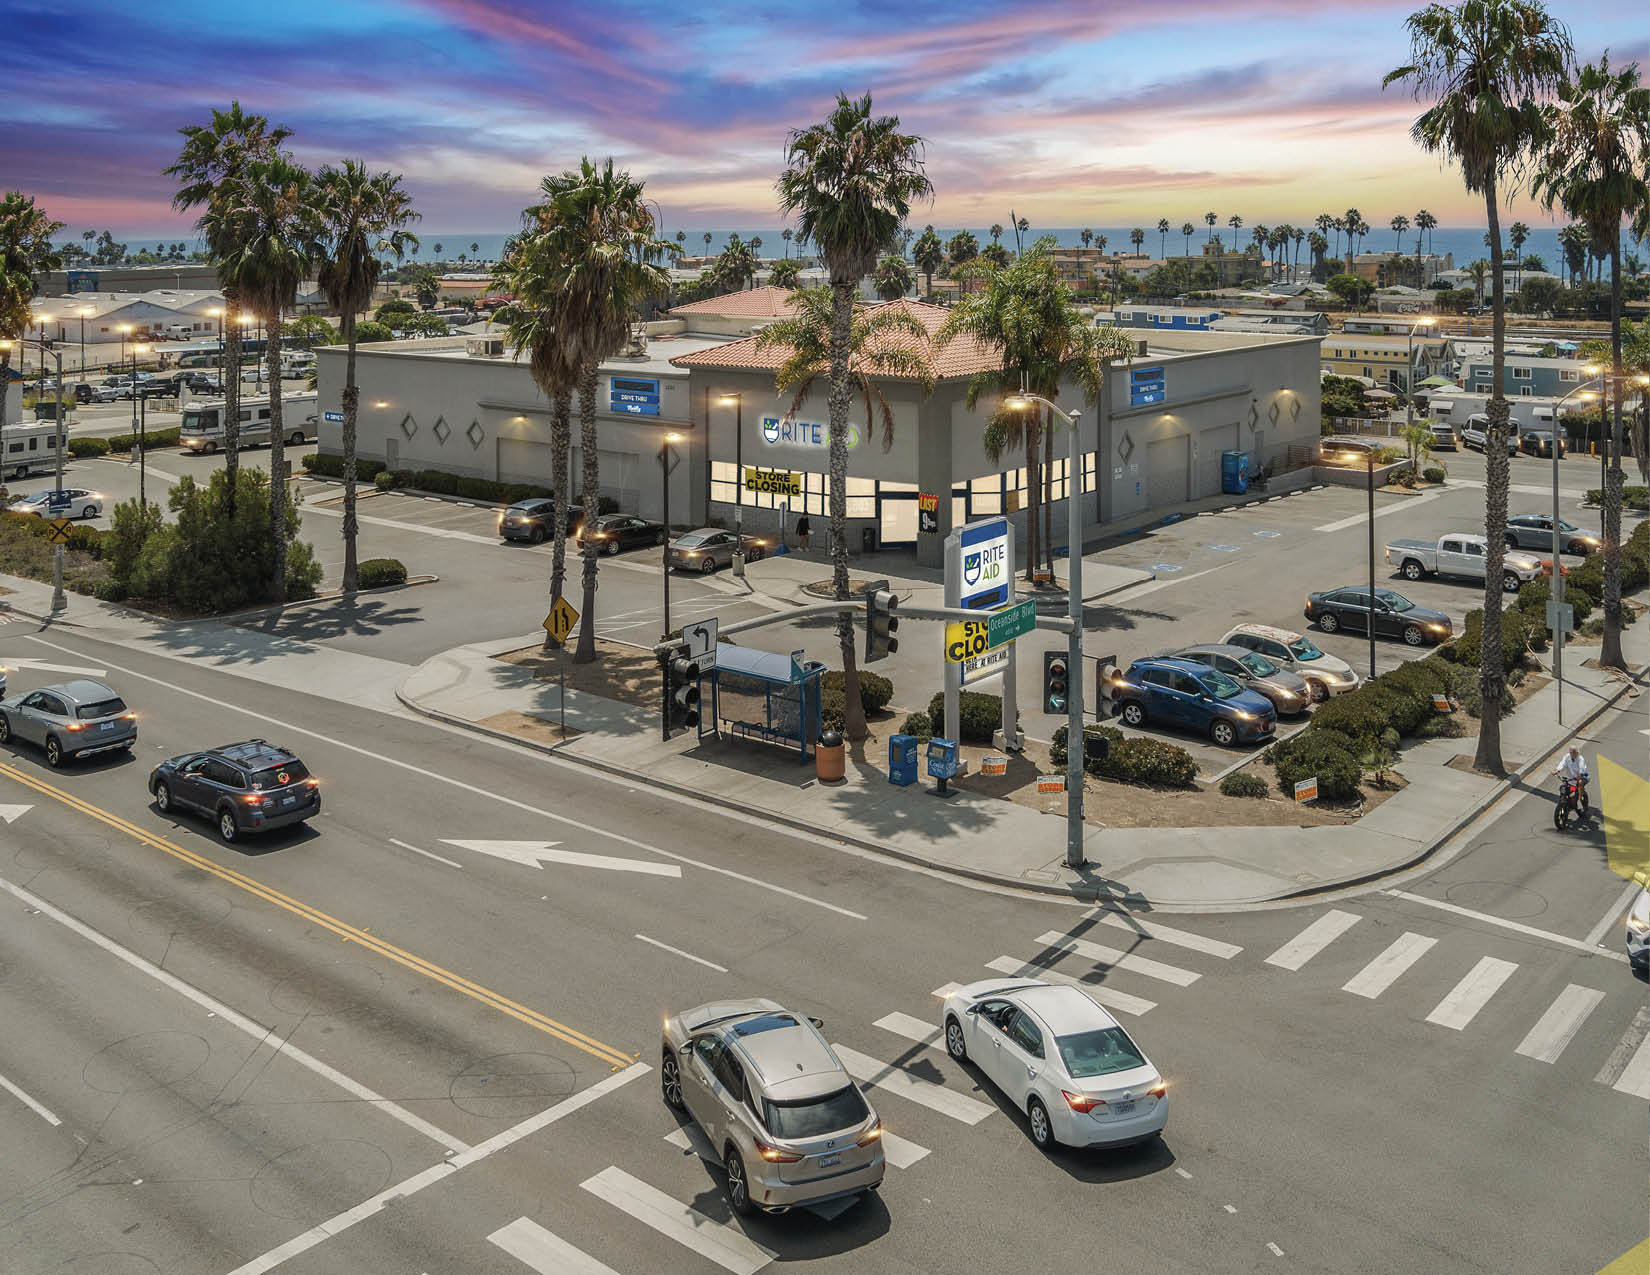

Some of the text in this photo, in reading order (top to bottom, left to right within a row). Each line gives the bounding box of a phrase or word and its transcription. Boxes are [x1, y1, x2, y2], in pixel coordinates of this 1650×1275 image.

[781, 422, 822, 444] RITE
[755, 471, 790, 482] STORE
[747, 479, 800, 495] CLOSING
[920, 497, 937, 512] LAST
[983, 544, 1005, 565] RITE
[983, 563, 1000, 581] AID
[991, 602, 1035, 631] Oceanside Blvd
